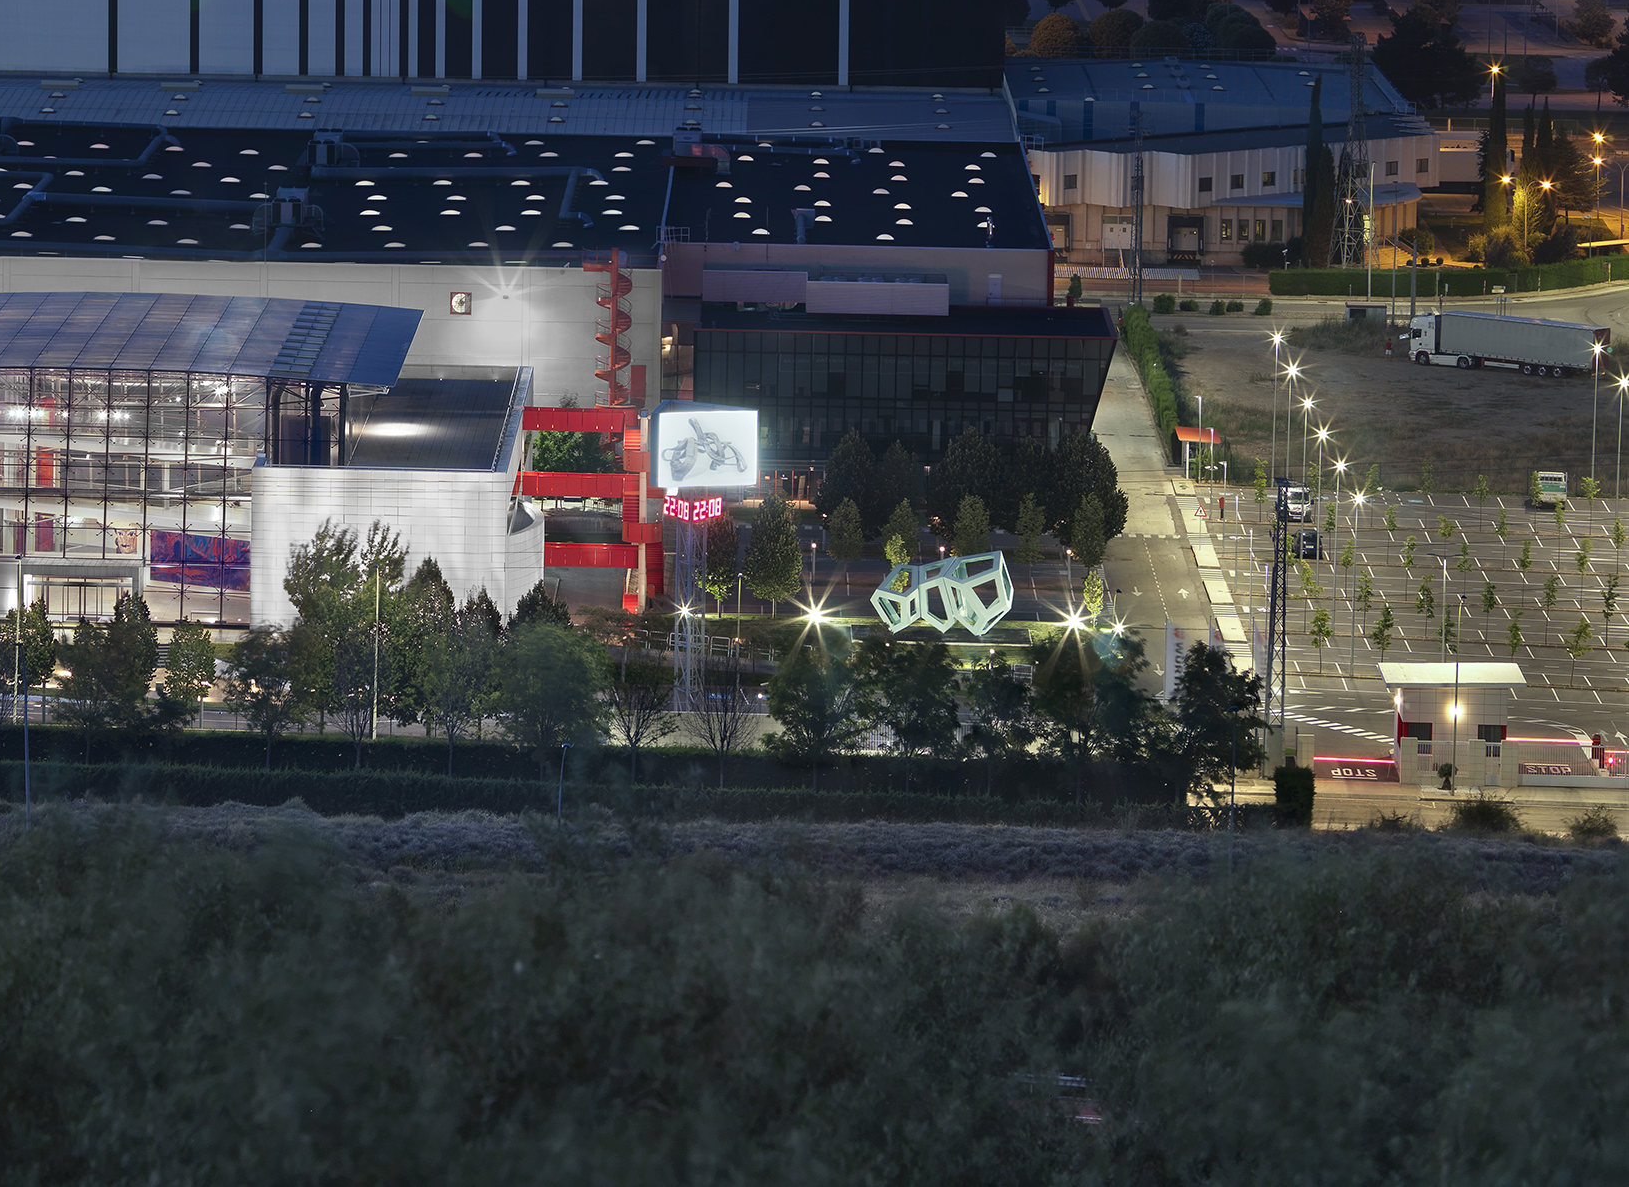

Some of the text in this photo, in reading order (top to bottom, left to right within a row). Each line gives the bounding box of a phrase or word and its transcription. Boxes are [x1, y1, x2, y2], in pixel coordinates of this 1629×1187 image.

[663, 496, 689, 521] 22:08
[693, 497, 722, 521] 22:08
[1331, 768, 1377, 777] STOP
[1526, 765, 1572, 774] STOP
